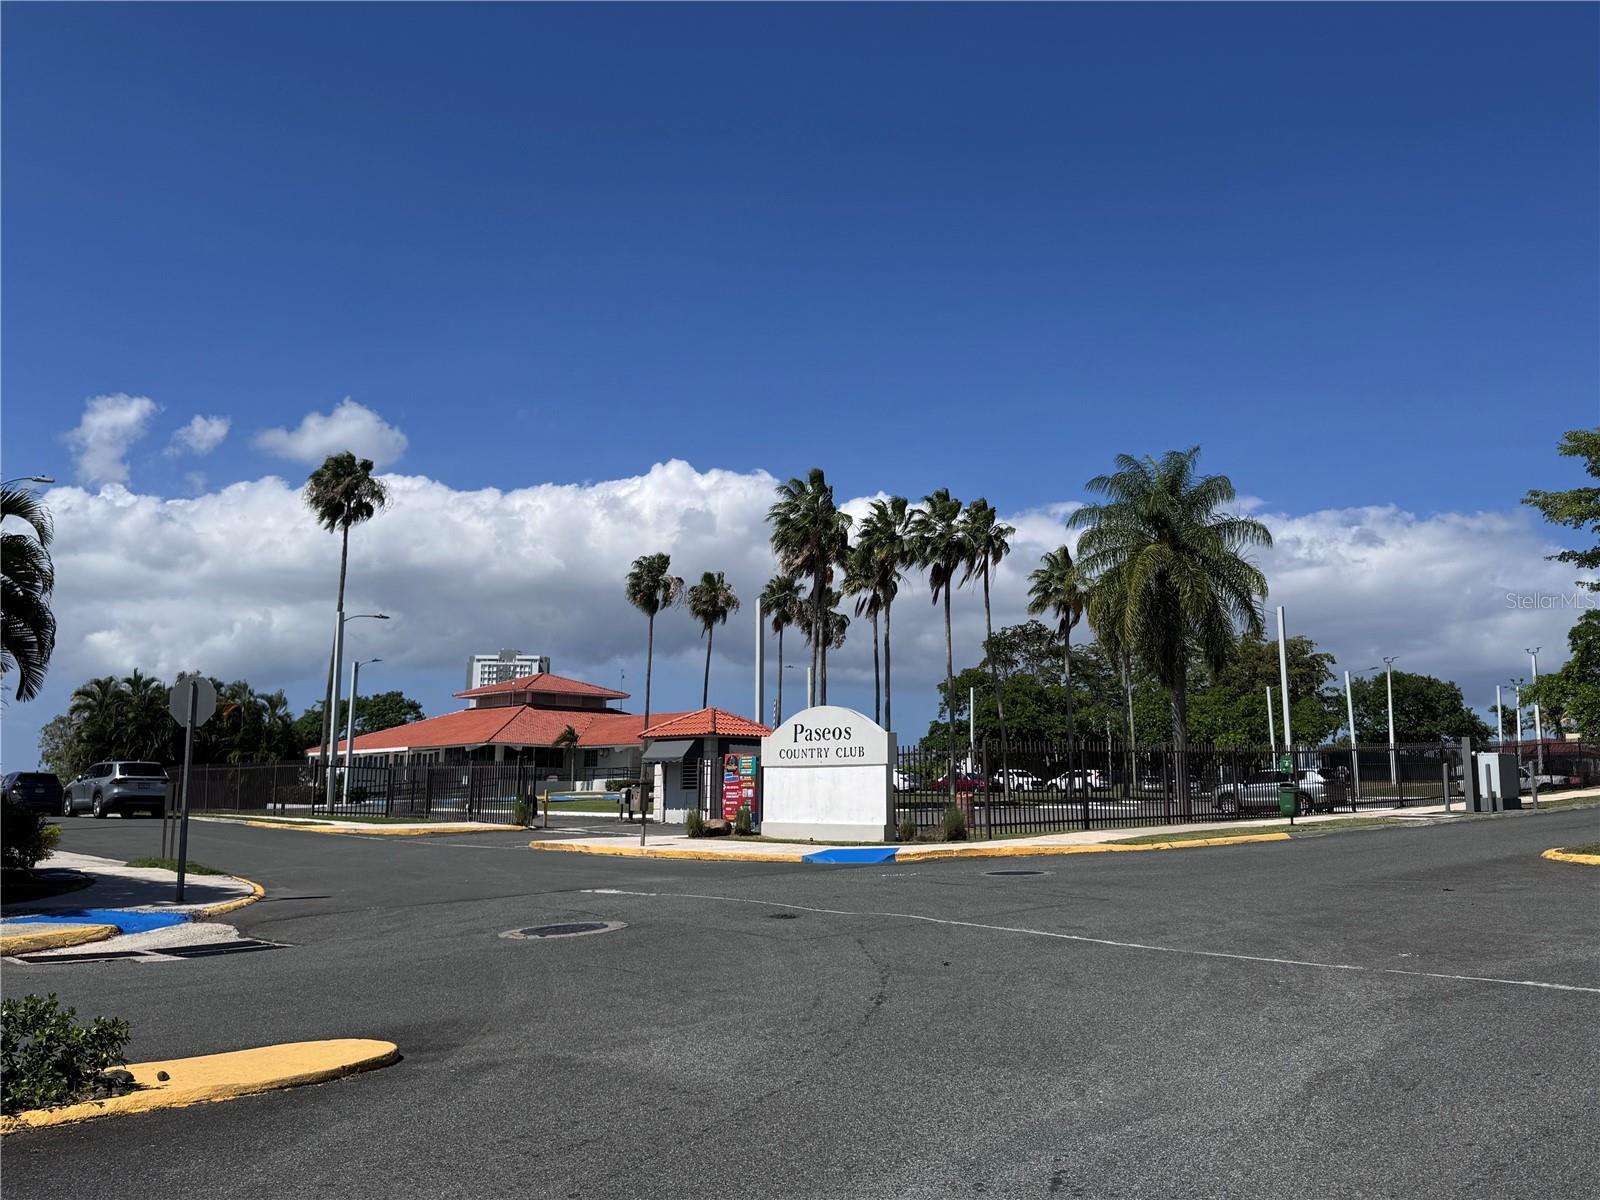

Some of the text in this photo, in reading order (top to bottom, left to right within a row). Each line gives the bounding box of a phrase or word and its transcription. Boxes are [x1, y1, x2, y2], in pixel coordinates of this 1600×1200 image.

[793, 723, 852, 743] Paseos
[779, 746, 865, 760] COUNTRY CLUB
